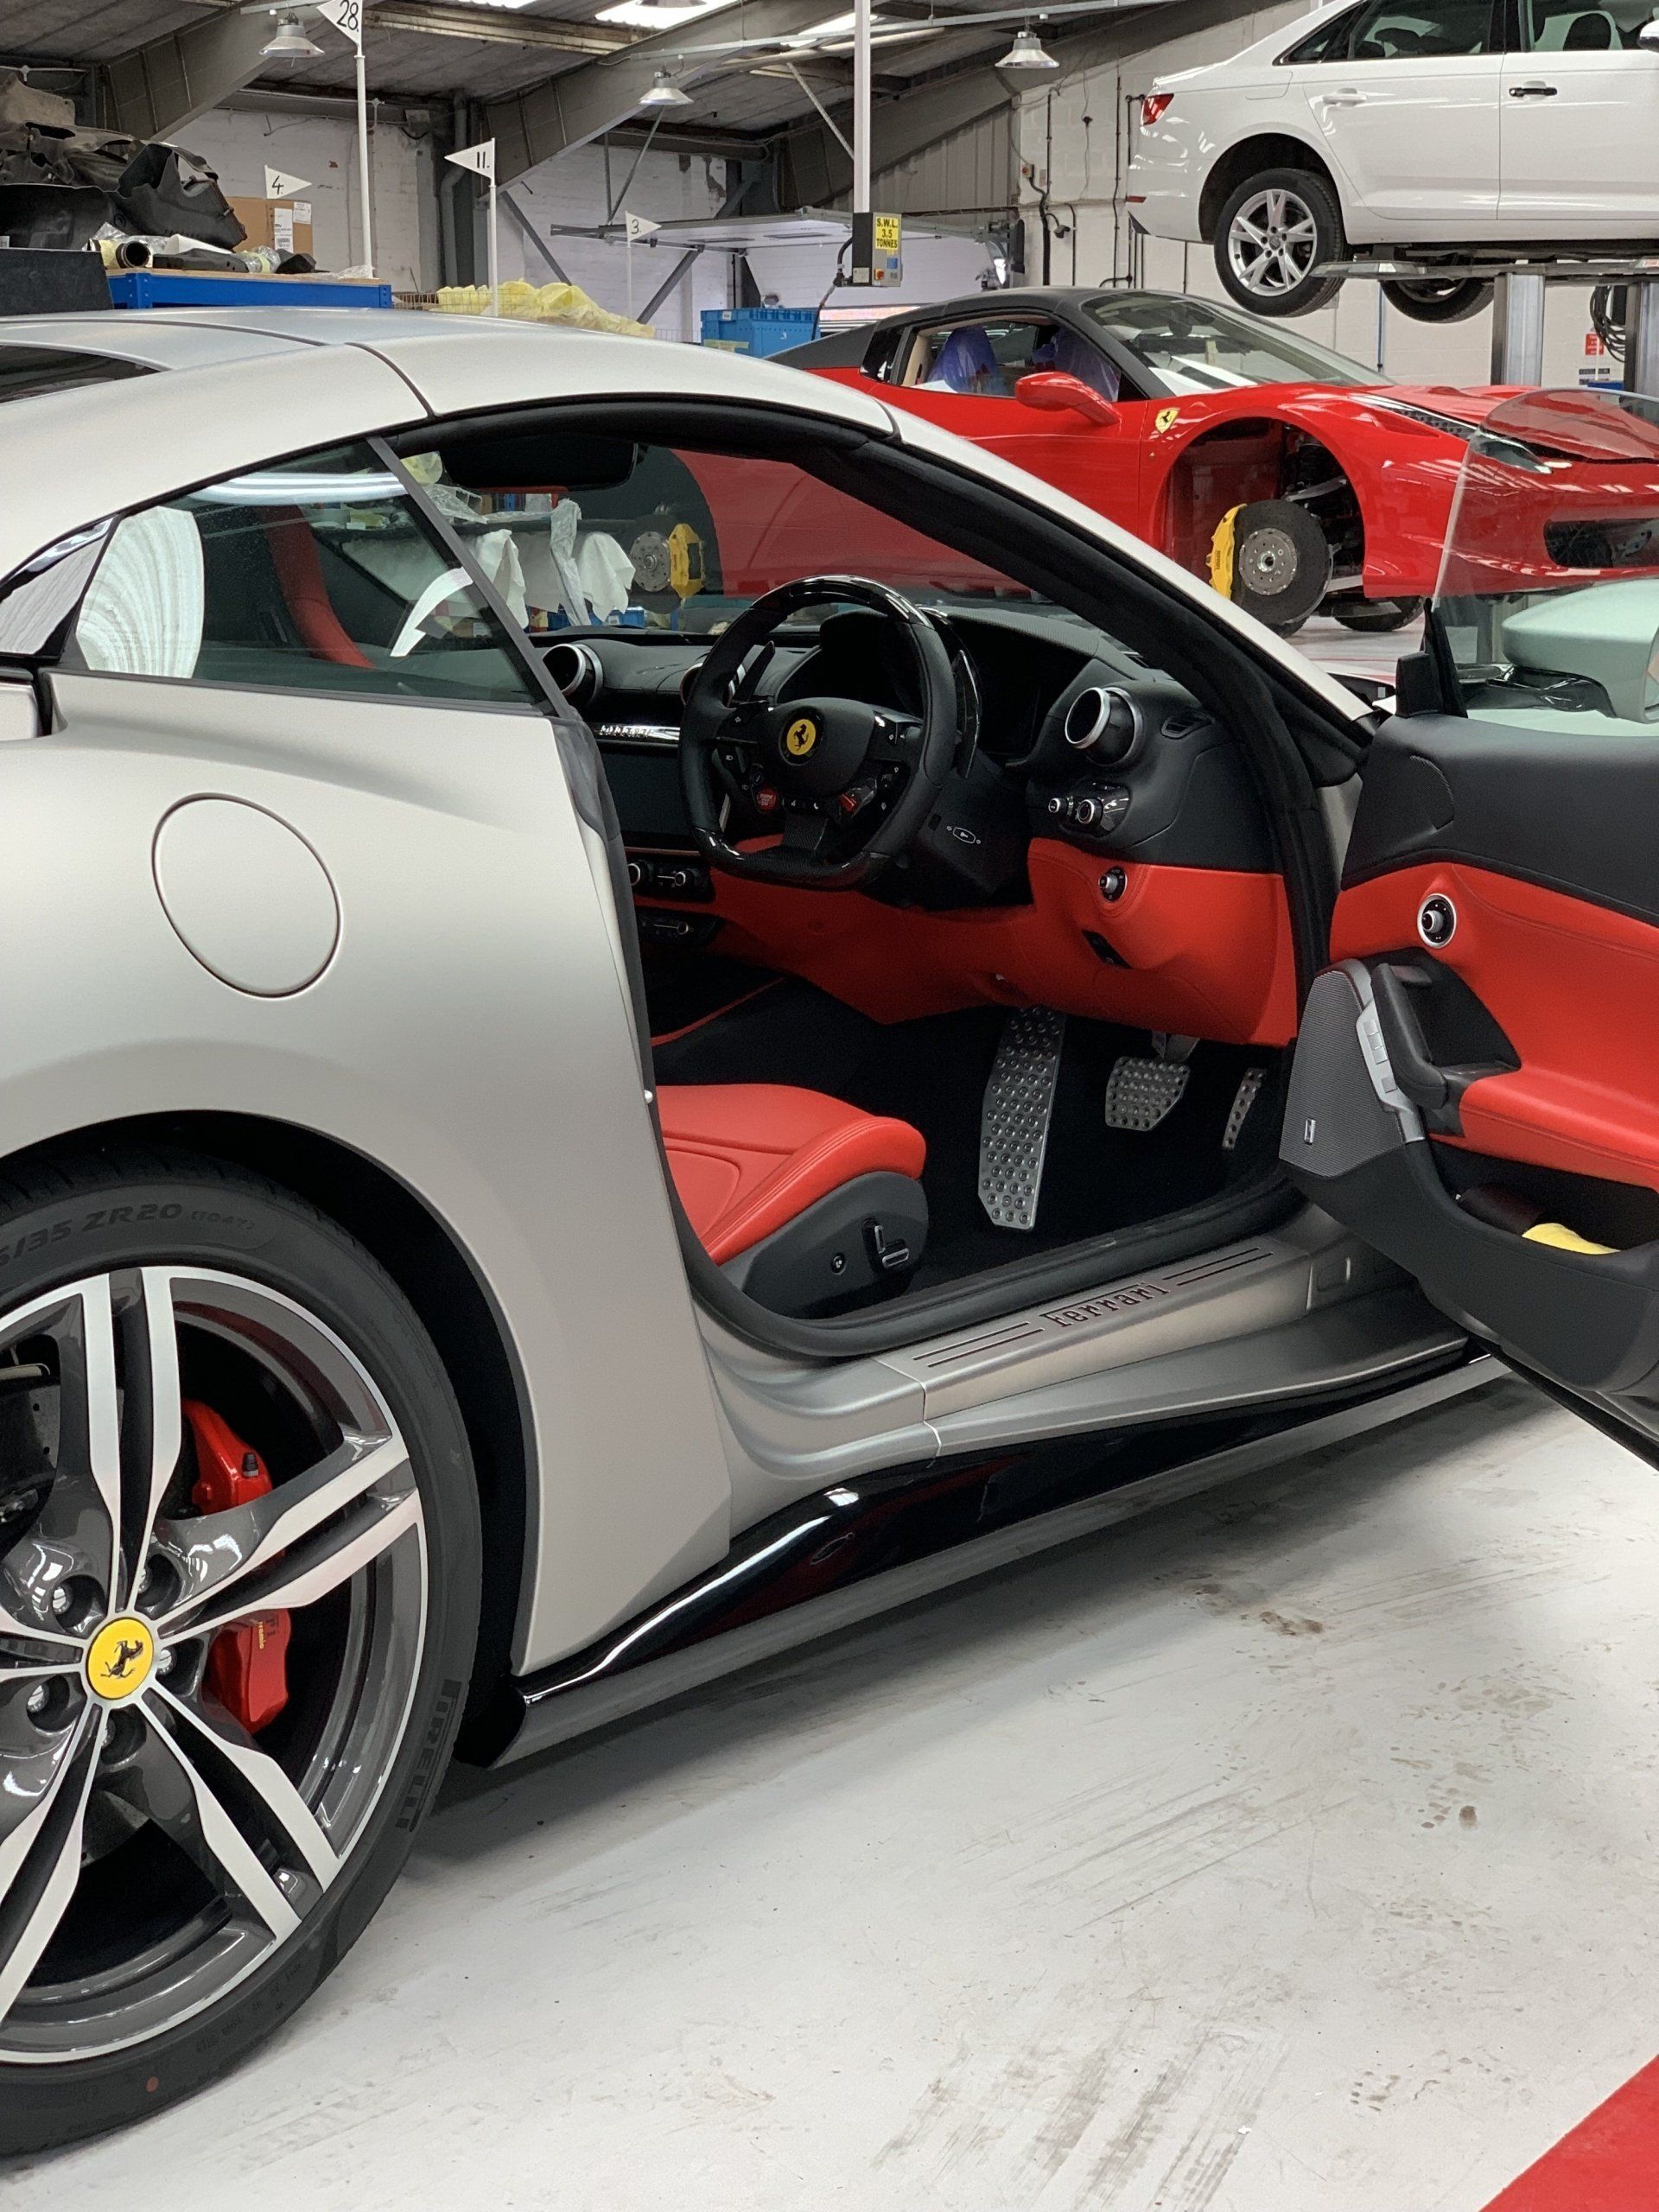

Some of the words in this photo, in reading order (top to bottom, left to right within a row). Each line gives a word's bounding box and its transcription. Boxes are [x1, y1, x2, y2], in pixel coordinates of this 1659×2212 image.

[876, 238, 898, 249] TONNES
[881, 228, 893, 238] 3.5
[82, 1203, 183, 1232] ZR20
[1039, 1281, 1170, 1328] Ferrari
[395, 1679, 462, 1831] PIRELLI
